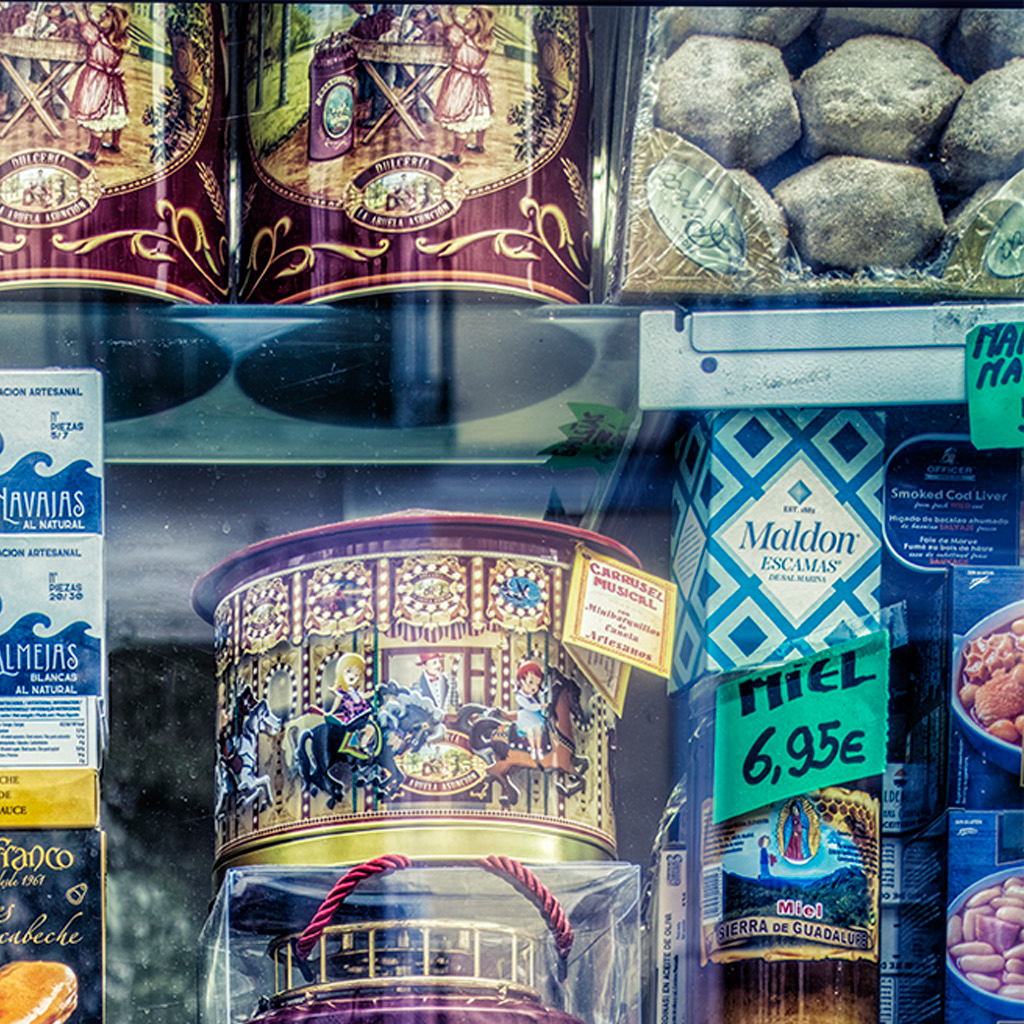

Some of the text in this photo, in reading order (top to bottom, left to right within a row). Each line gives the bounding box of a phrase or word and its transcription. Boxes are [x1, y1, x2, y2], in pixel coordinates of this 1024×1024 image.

[29, 388, 83, 397] ARTESANAL
[926, 466, 973, 474] OFFICER
[891, 488, 1008, 501] Smoked Cod Liver
[23, 519, 85, 530] AL NATURAL
[739, 520, 856, 555] Maldon
[28, 548, 81, 557] ARTESANAL
[760, 555, 838, 574] ESCAMAS
[49, 584, 83, 592] PIEZAS
[590, 563, 664, 603] CARRUSEL
[48, 592, 84, 600] 20/30
[593, 576, 657, 611] MUSICAL
[605, 624, 639, 642] Canela
[585, 631, 652, 661] Artesanos
[30, 673, 78, 682] BLANCAS
[15, 685, 78, 695] AL NATURAL
[742, 720, 867, 786] 6,95€
[777, 900, 824, 919] Miel
[718, 919, 869, 949] SIERRA DE GUADALUPE
